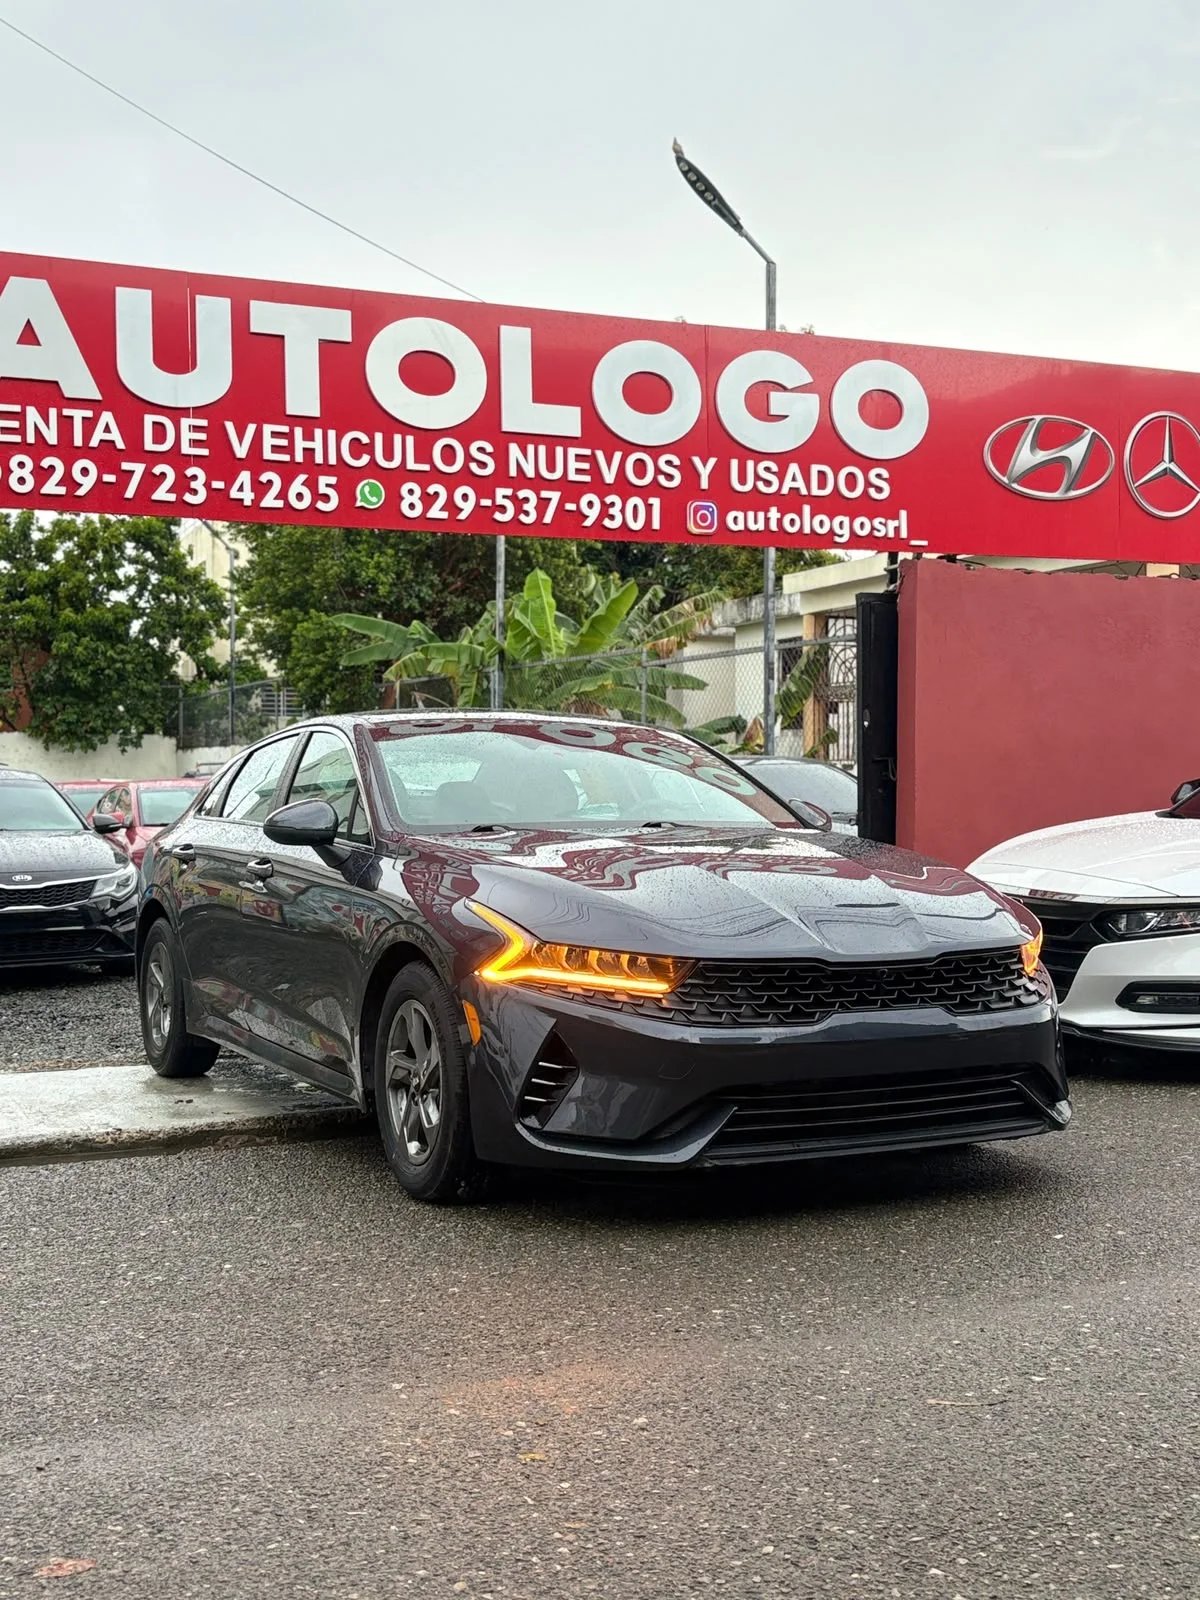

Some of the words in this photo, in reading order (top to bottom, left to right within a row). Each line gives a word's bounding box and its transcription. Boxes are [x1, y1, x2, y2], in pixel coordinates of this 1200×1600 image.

[0, 275, 930, 460] AUTOLOGO
[8, 453, 340, 512] 829-723-4265
[400, 482, 662, 531] 829-537-9301
[725, 504, 929, 546] autologosrl_
[144, 414, 210, 456] DE
[224, 420, 496, 477] VEHICULOS
[508, 443, 682, 489] NUEVOS
[691, 455, 718, 490] Y
[730, 459, 891, 501] USADOS
